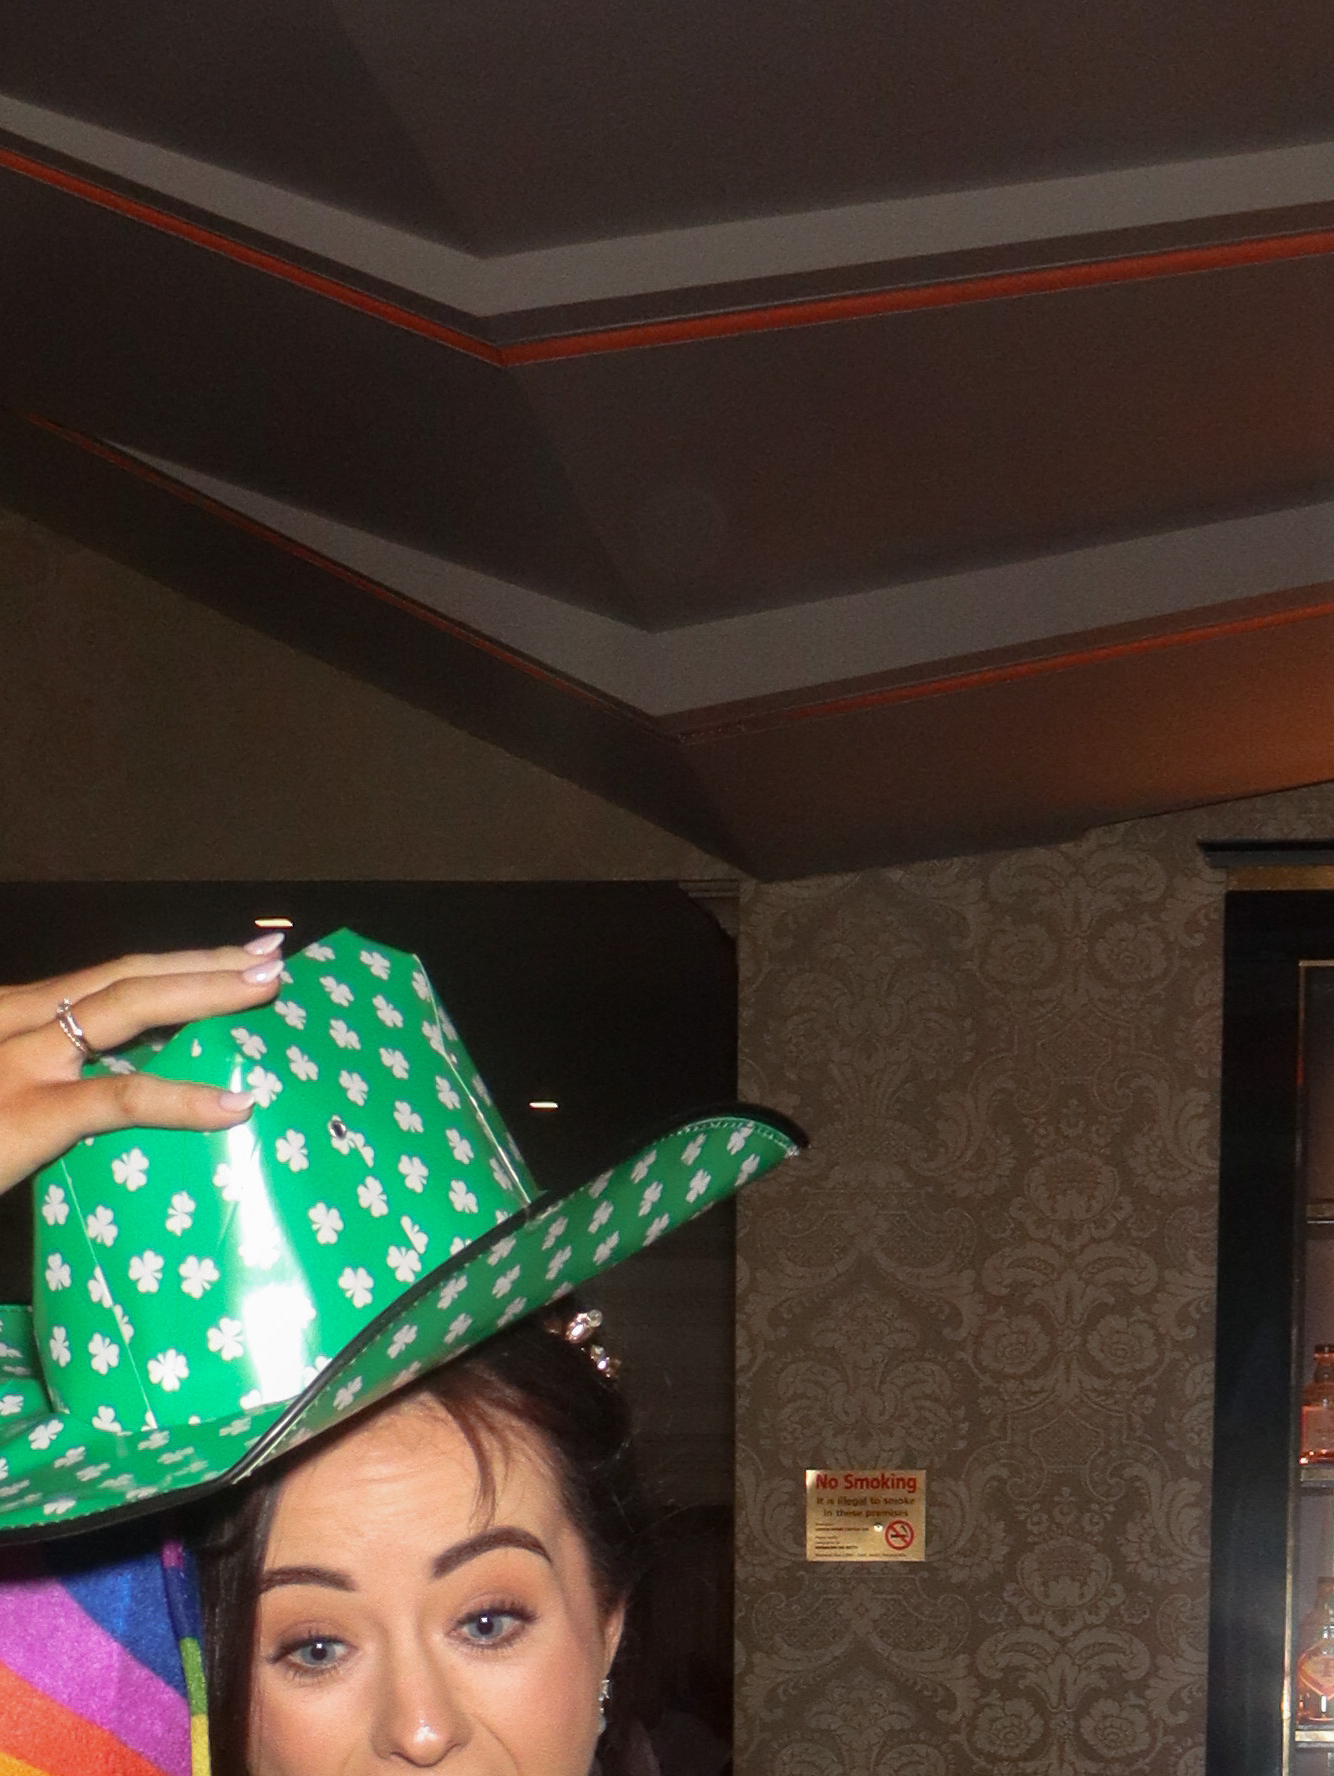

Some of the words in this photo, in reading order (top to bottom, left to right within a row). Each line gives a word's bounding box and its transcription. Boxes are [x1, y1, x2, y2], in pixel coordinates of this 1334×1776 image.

[816, 1474, 839, 1490] No
[844, 1473, 917, 1493] Smoking
[865, 1509, 909, 1517] premises
